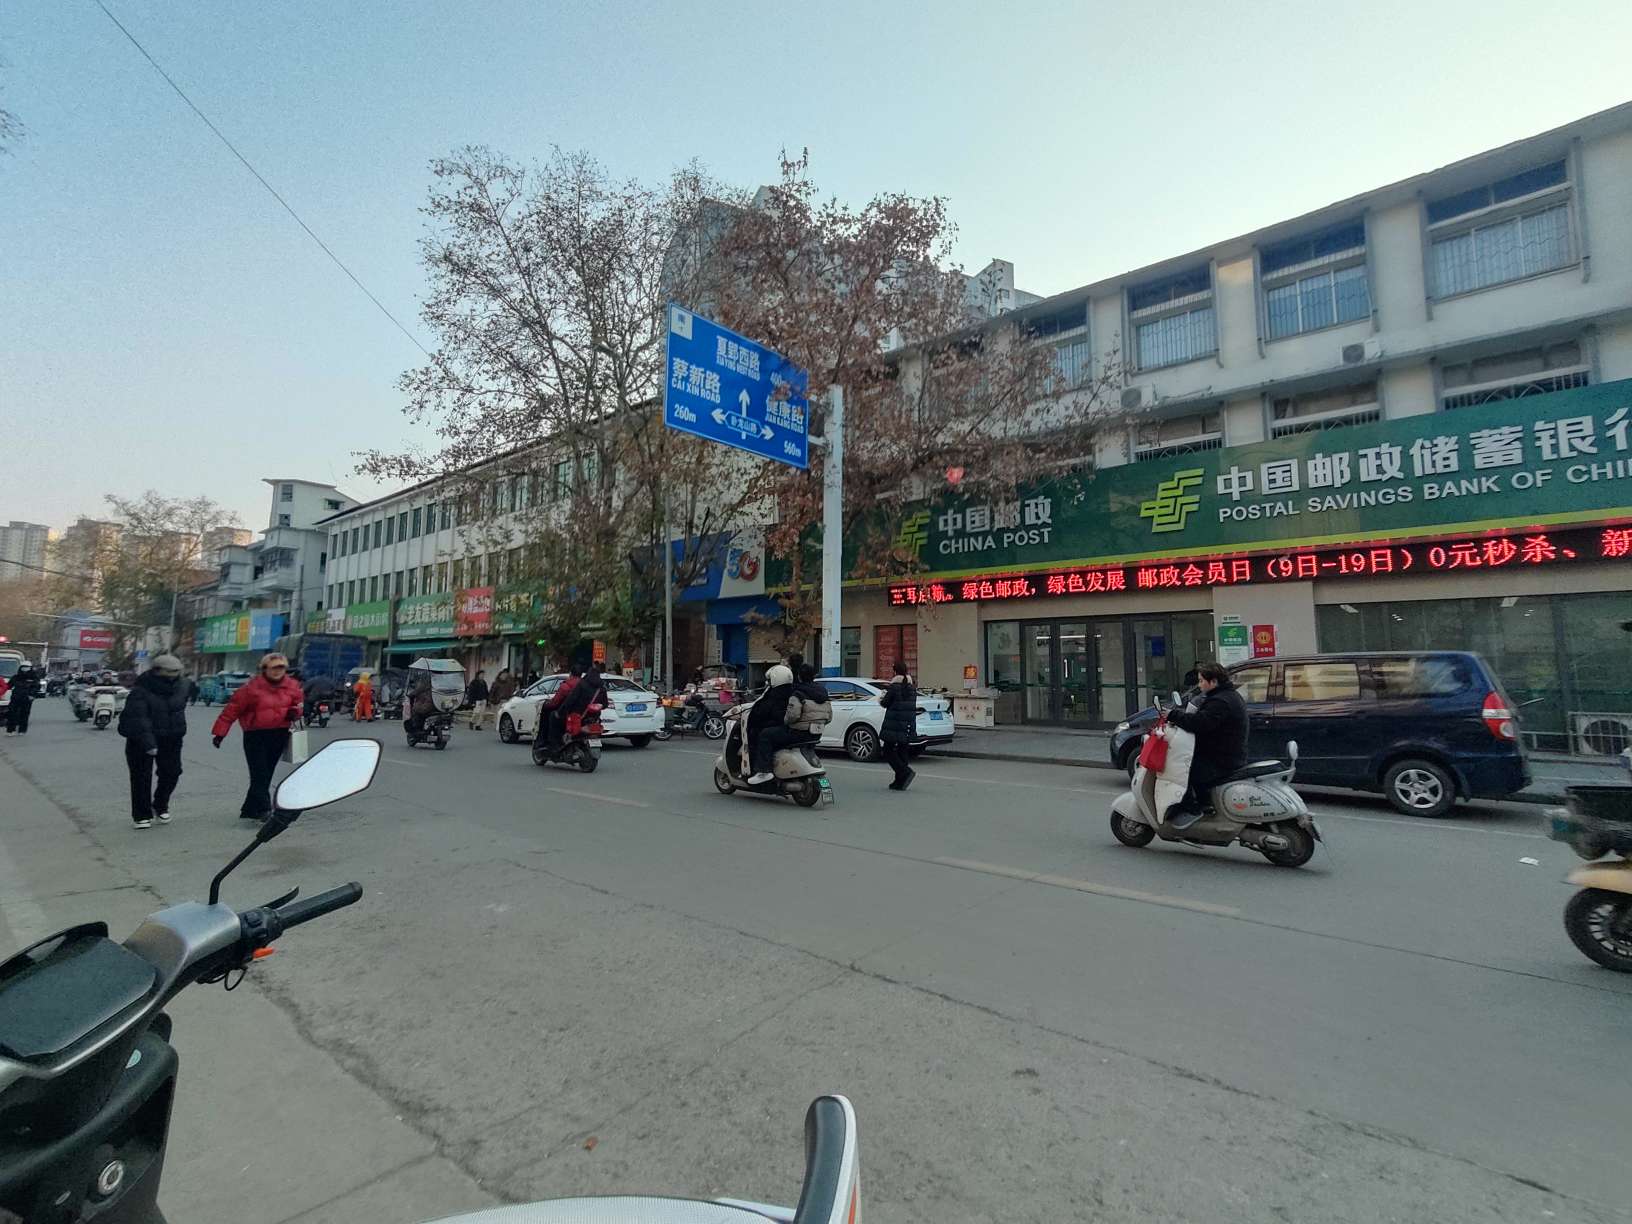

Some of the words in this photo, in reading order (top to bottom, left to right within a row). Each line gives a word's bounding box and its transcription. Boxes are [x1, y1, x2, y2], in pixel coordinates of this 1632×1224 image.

[671, 377, 685, 391] CAI
[686, 383, 700, 396] XIN
[700, 389, 721, 404] ROAD
[673, 403, 697, 423] 260m
[1218, 501, 1300, 522] POSTAL
[1307, 486, 1413, 512] SAVINGS
[1423, 475, 1501, 500] BANK
[1511, 468, 1553, 489] OF
[1566, 458, 1632, 483] CHI
[938, 495, 1053, 537] 中国邮政
[939, 534, 996, 555] CHINA
[1003, 527, 1053, 548] POST
[727, 548, 761, 582] 5G
